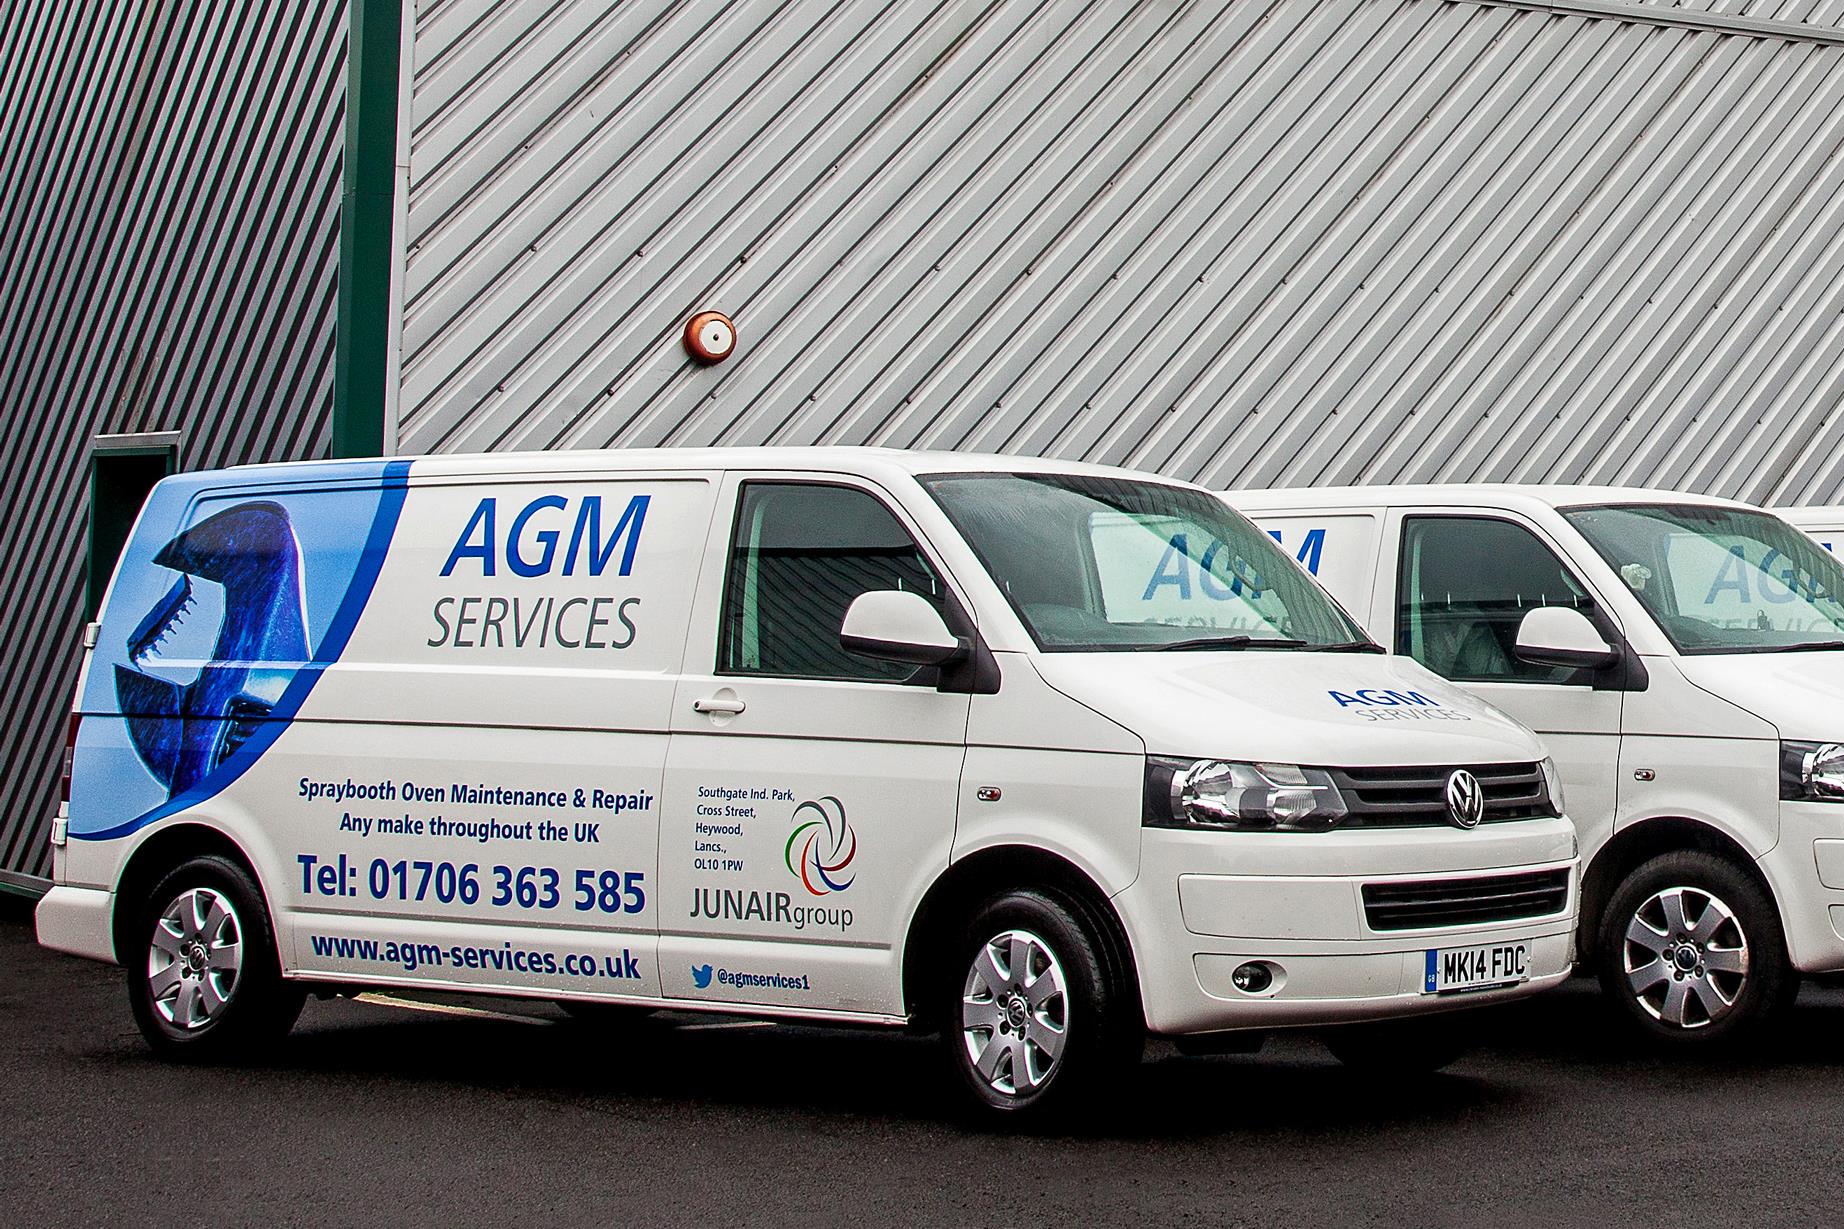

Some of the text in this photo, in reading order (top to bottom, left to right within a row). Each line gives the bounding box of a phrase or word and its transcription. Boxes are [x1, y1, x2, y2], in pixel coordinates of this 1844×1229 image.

[439, 494, 652, 578] AGM
[427, 597, 641, 649] SERVICES
[1328, 689, 1440, 707] AGM
[1355, 708, 1471, 721] SERVICES
[298, 777, 653, 815] Spraybooth Oven Maintenance & Repair
[698, 786, 795, 802] Southgate Ind. Park,
[697, 804, 757, 819] Cross Street,
[340, 812, 600, 843] Any make throughout the UK
[695, 822, 744, 837] Heywood,
[694, 840, 727, 854] Lancs.,
[694, 858, 743, 872] OL10 1PW
[297, 853, 646, 915] Tel: 01706 363 585
[311, 934, 642, 980] www.agm-services.co.uk
[1444, 945, 1526, 984] MK14 FDC
[717, 968, 810, 990] @agmservices1
